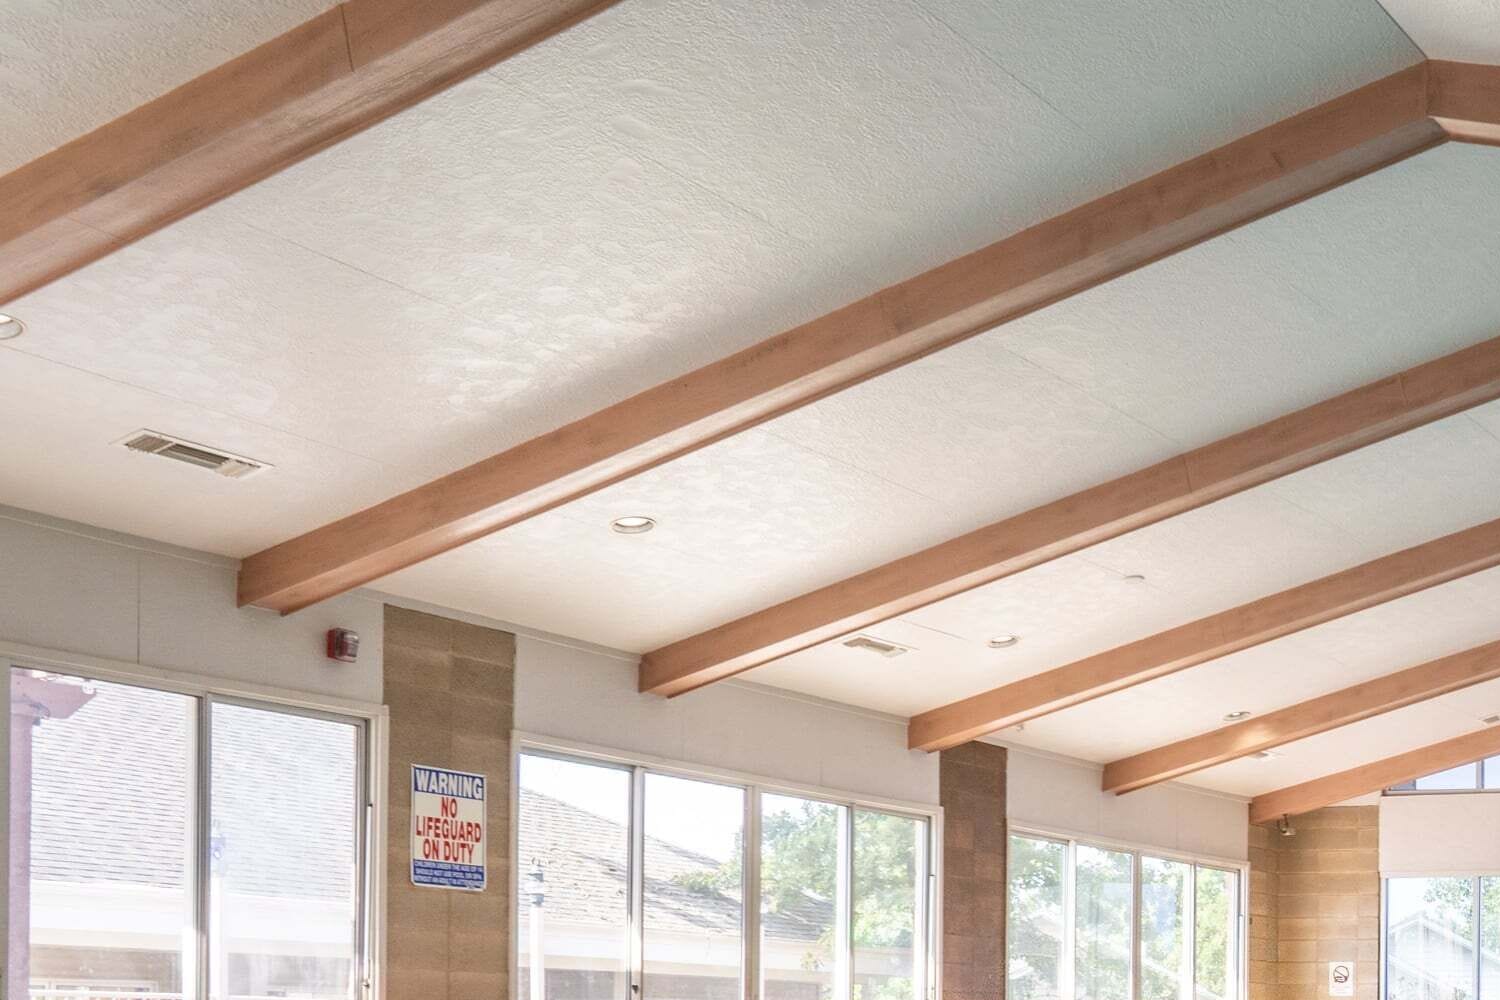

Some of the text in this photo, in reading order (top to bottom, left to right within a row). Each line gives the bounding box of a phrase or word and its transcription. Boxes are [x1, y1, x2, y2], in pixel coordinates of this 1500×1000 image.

[415, 769, 483, 799] WARNING
[441, 797, 458, 818] NO
[416, 815, 482, 843] LIFEGUARD
[423, 839, 475, 864] ON DUTY
